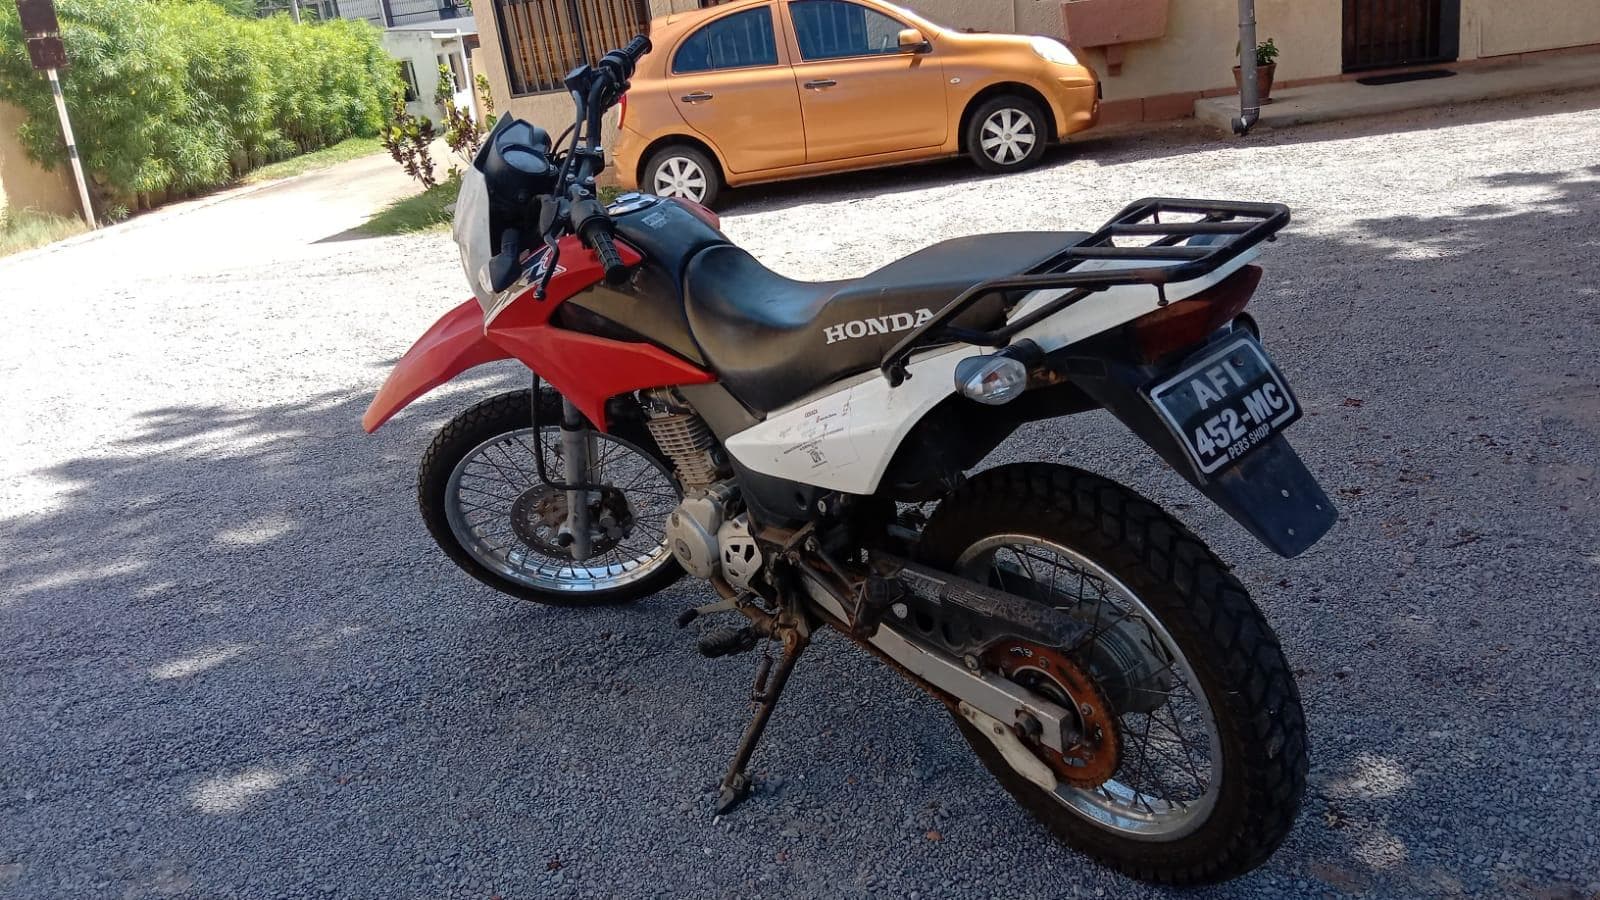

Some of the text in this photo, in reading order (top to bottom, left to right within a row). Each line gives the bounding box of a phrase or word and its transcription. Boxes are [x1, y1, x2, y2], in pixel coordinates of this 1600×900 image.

[823, 308, 935, 345] HONDA
[1190, 360, 1245, 410] AFI
[1195, 382, 1283, 457] 452-MC
[1228, 423, 1270, 460] PERS SHOP
